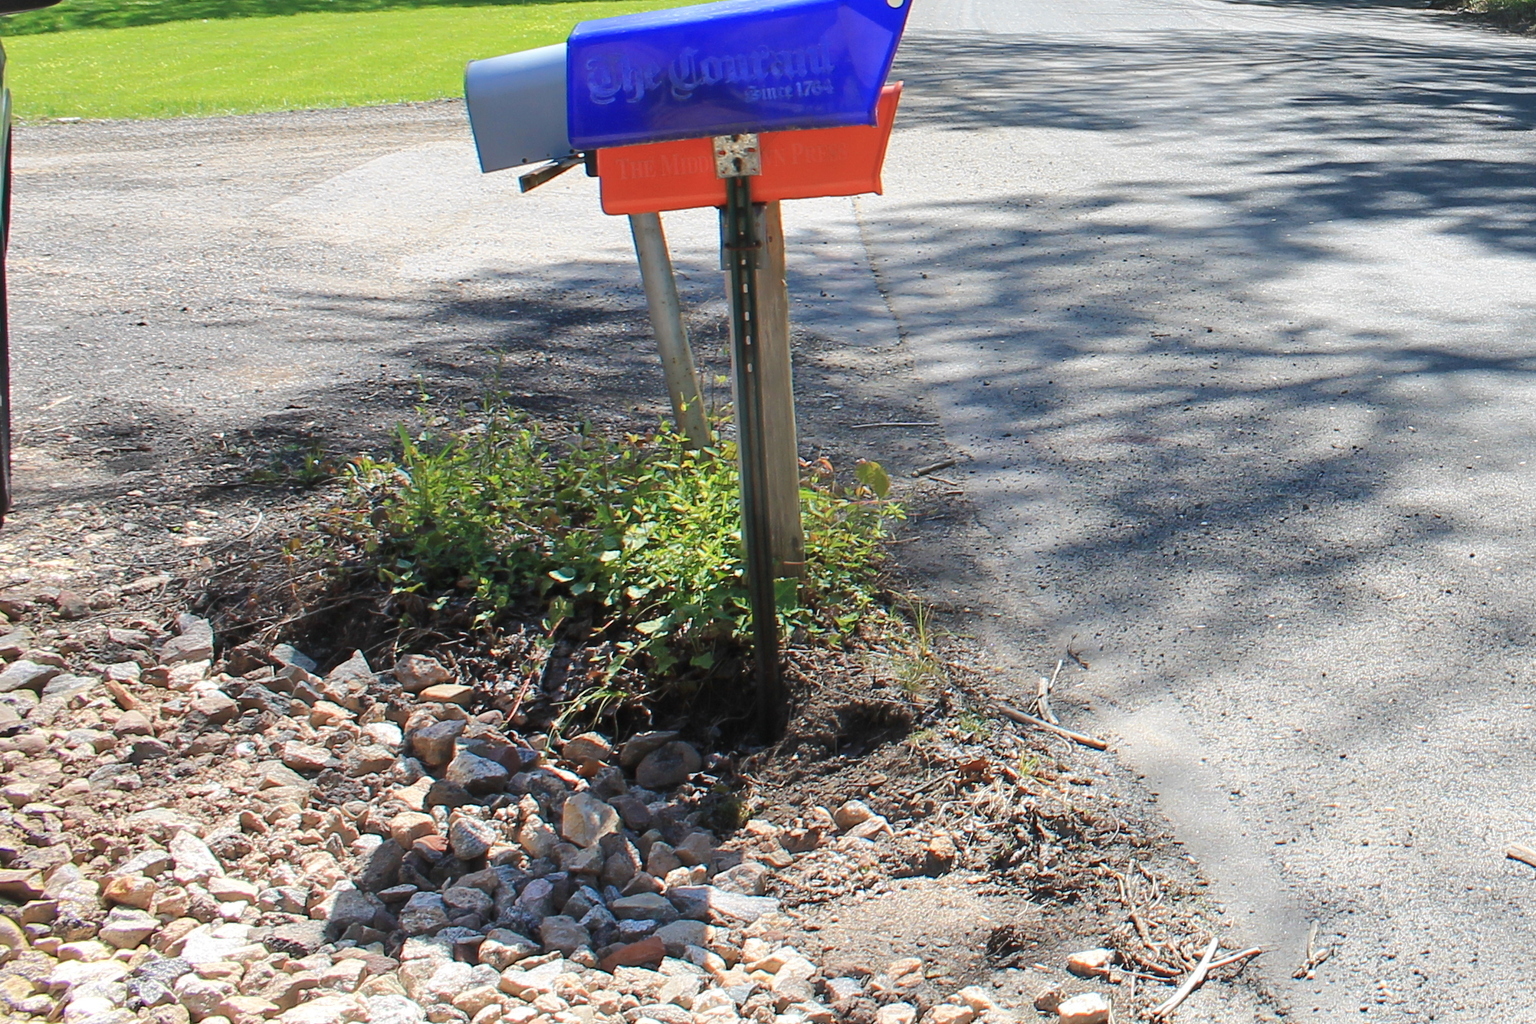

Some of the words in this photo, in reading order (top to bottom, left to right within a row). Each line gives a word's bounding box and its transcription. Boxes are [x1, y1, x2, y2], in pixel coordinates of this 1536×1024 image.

[586, 56, 662, 105] The
[669, 43, 835, 101] Courant
[744, 85, 793, 103] Since
[796, 78, 834, 97] 1764
[616, 158, 656, 180] THE
[791, 142, 849, 165] PRESS
